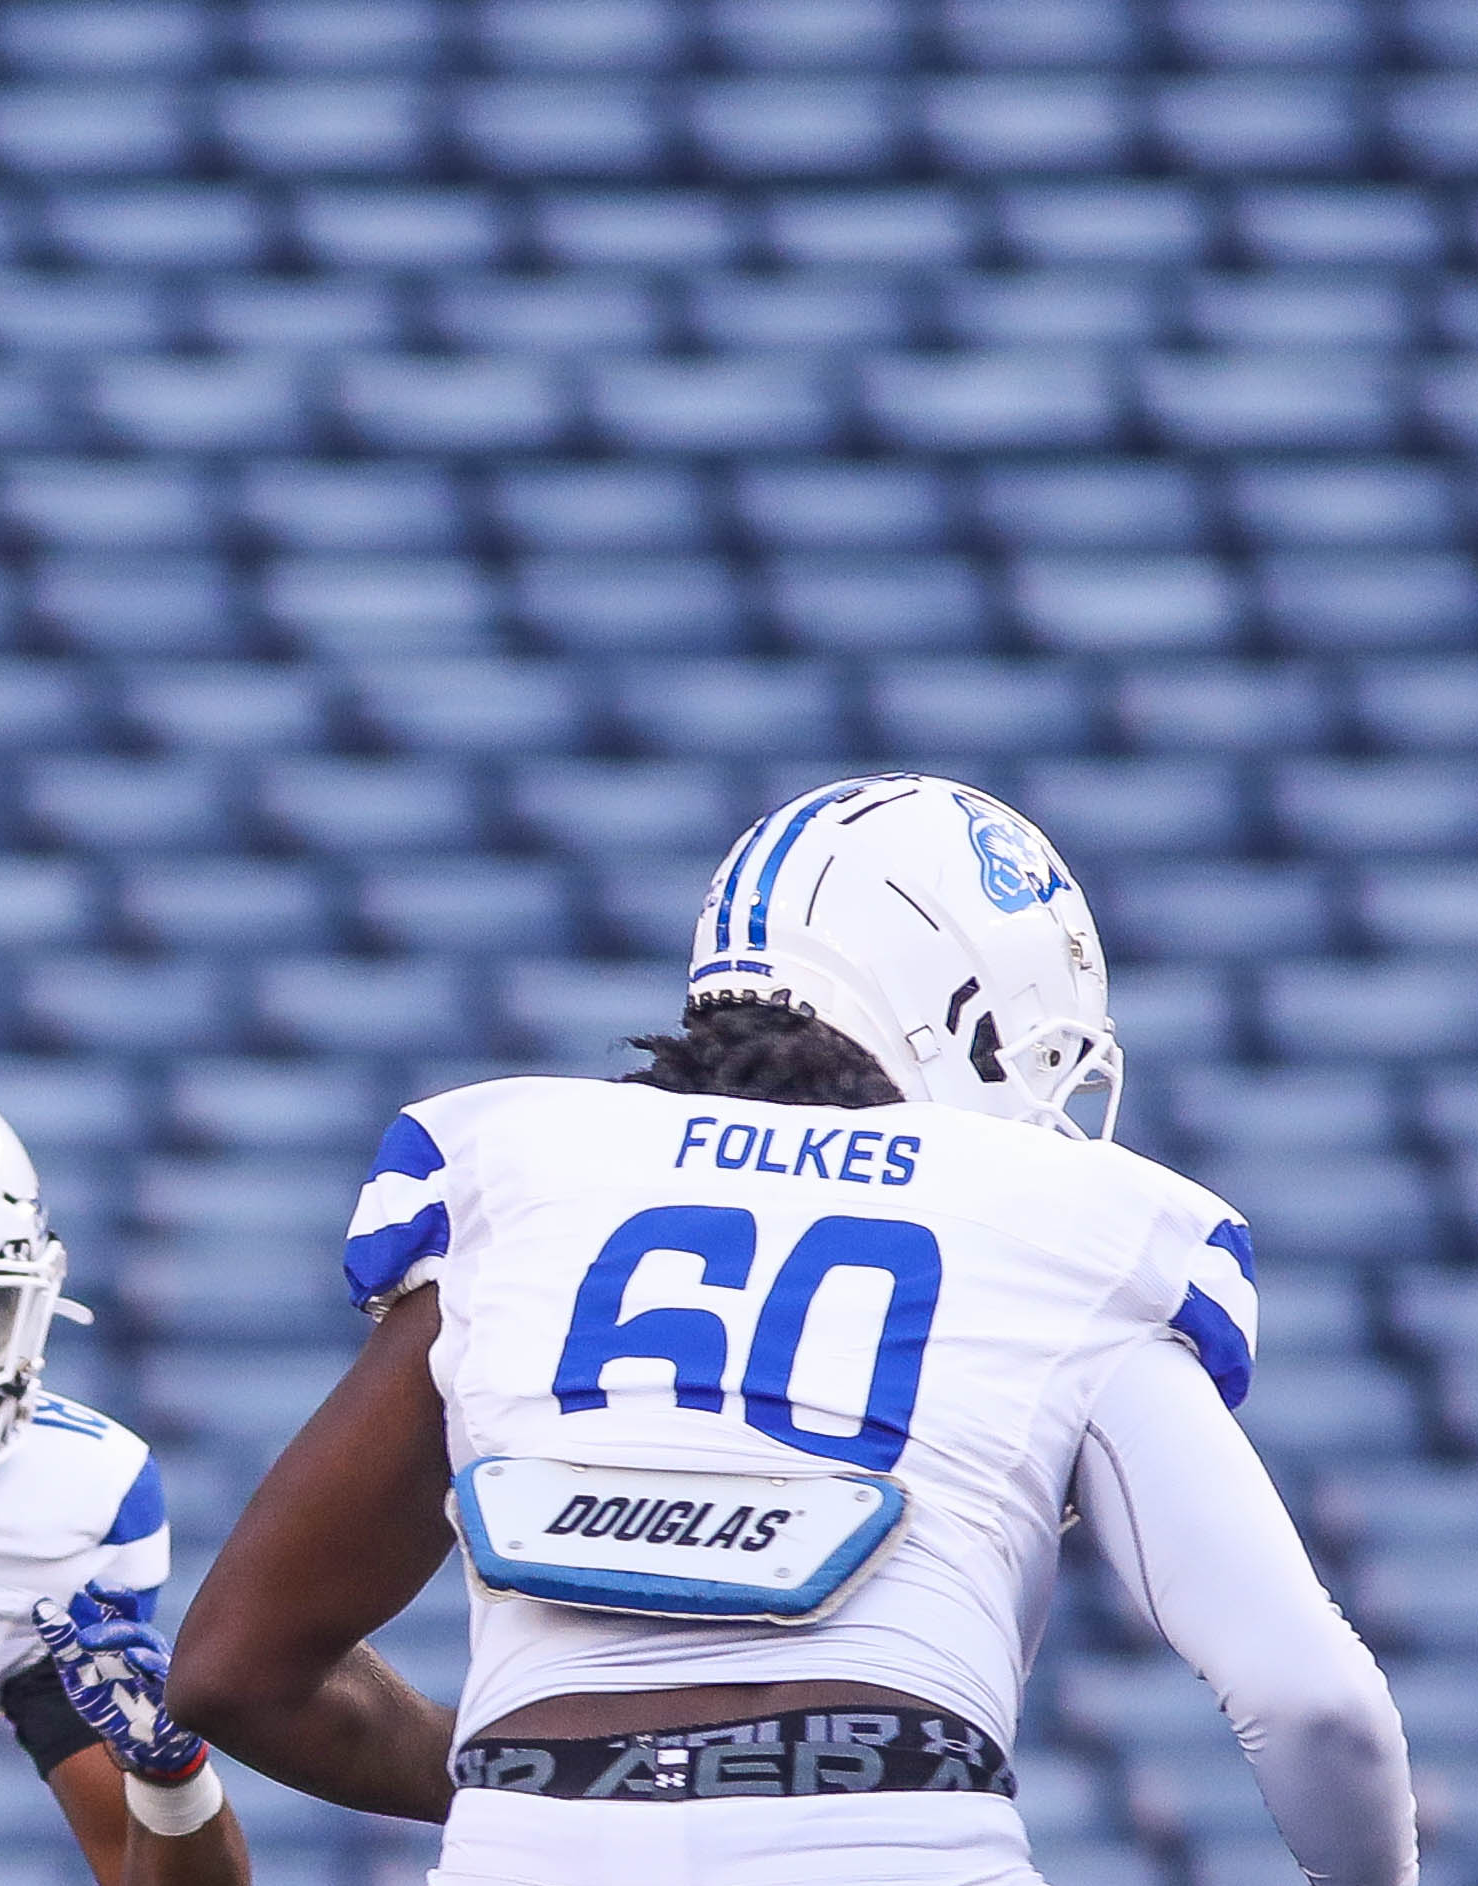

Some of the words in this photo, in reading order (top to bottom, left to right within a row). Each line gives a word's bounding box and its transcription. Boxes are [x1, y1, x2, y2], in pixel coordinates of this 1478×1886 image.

[675, 1117, 922, 1186] FOLKES
[552, 1204, 942, 1473] 60
[544, 1494, 792, 1552] DOUGLAS
